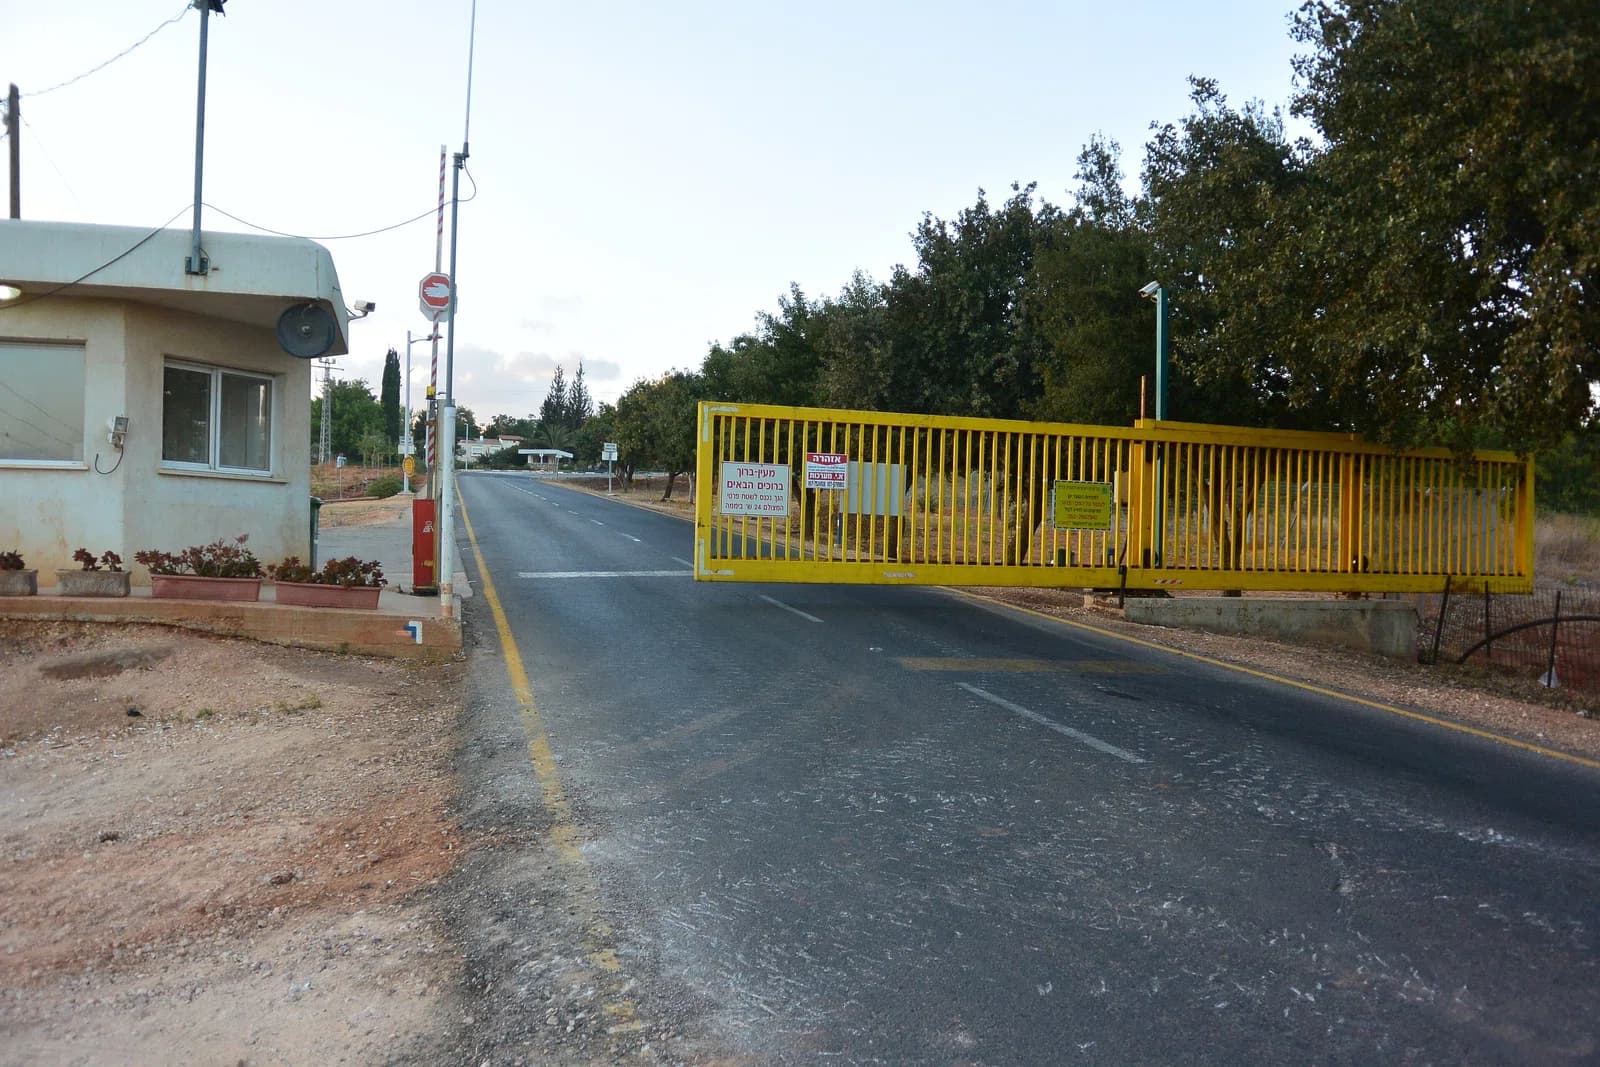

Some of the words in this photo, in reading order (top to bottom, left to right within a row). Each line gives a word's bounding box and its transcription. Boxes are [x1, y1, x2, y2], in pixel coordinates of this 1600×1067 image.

[812, 455, 841, 463] אזהרה
[737, 467, 776, 479] מעין-ברוך
[809, 472, 833, 480] מערכות
[727, 480, 754, 489] הבאים
[757, 481, 784, 491] ברוכים
[727, 492, 740, 500] פרטי
[741, 492, 758, 500] לשטח
[774, 495, 784, 503] הנך
[725, 502, 743, 510] ביממה
[763, 503, 784, 511] המצולם
